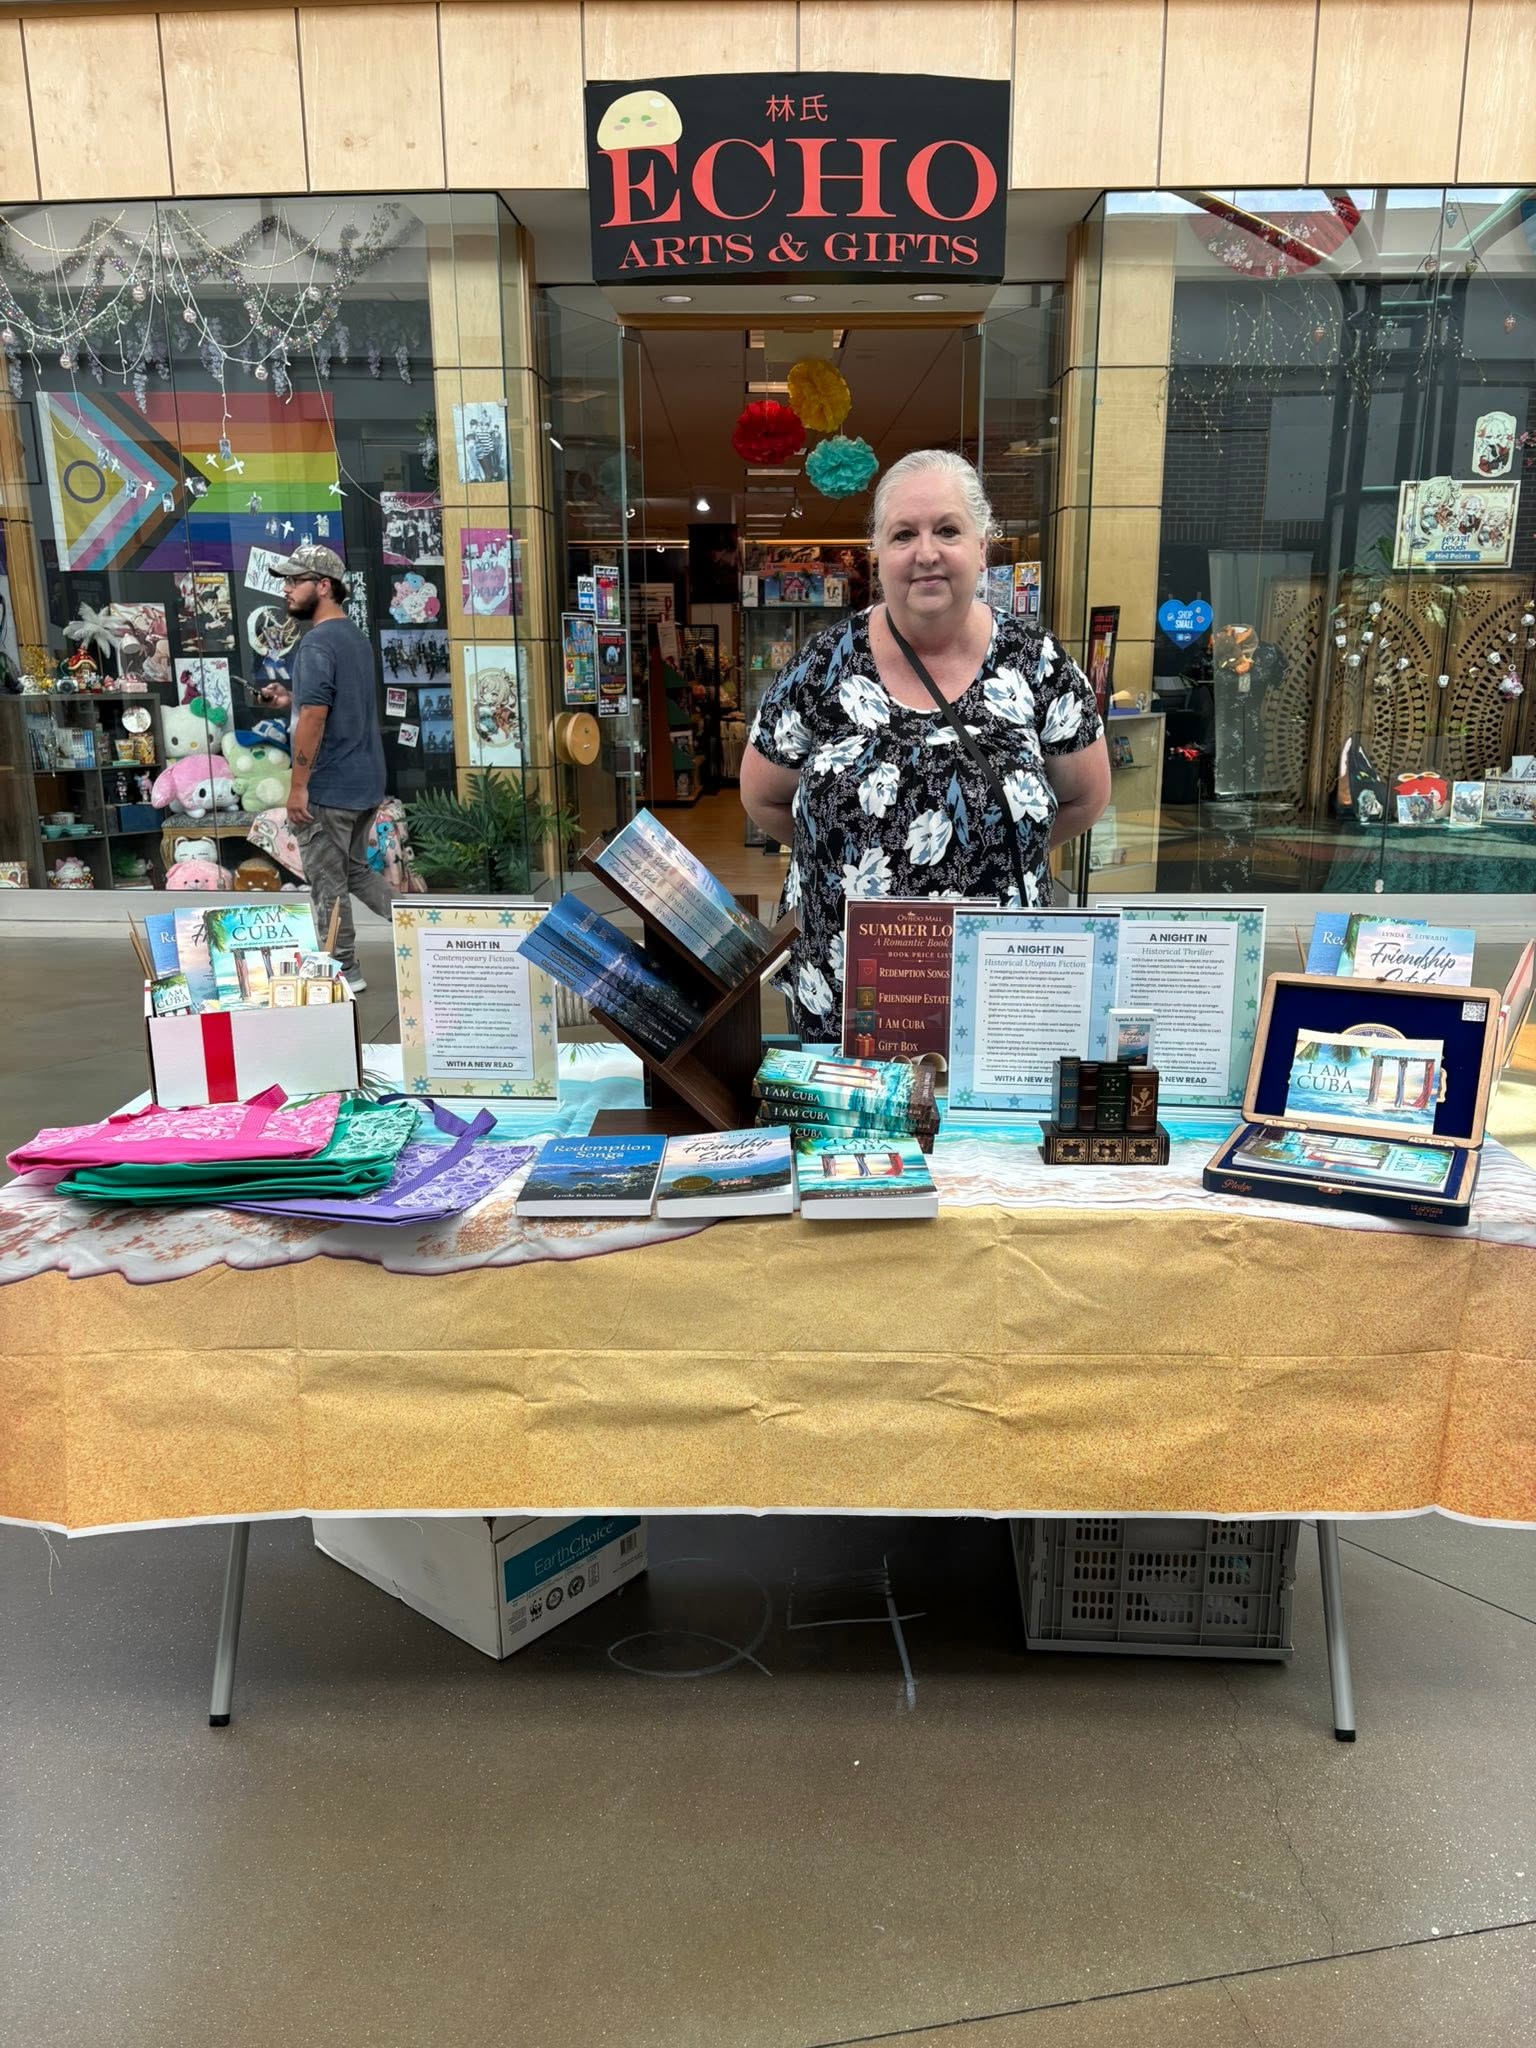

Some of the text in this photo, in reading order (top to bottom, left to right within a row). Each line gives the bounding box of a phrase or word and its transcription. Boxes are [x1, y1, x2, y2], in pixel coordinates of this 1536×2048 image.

[765, 94, 829, 123] 林氏
[597, 137, 998, 228] ECHO
[618, 231, 979, 269] ARTS & GIFTS
[1441, 542, 1467, 551] Goods
[579, 581, 594, 592] OPEN
[1177, 610, 1193, 620] SHOP
[1175, 619, 1194, 630] SMALL
[239, 910, 283, 926] I AM
[232, 924, 293, 942] CUBA
[859, 924, 928, 937] SUMMER
[874, 938, 949, 947] A Romantic Book
[1149, 933, 1207, 943] A NIGHT IN
[1415, 933, 1449, 942] EDWARDS
[446, 940, 500, 950] A NIGHT IN
[1007, 945, 1064, 954] A NIGHT IN
[1141, 947, 1214, 956] Historical Thriller
[433, 953, 515, 964] Contemporary Fiction
[984, 958, 1086, 969] Historical Utopian Fiction
[1371, 941, 1456, 977] Friendship
[879, 967, 950, 978] REDEMPTION SONGS
[169, 988, 184, 997] AM
[879, 992, 951, 1004] FRIENDSHIP ESTATE
[156, 995, 190, 1009] CUBA
[878, 1018, 926, 1030] I AM CUBA
[878, 1040, 919, 1052] GIFT BOX
[446, 1060, 466, 1068] WITH
[493, 1061, 514, 1069] READ
[1307, 1062, 1348, 1078] I AM
[994, 1074, 1016, 1082] WITH
[1016, 1075, 1023, 1083] A
[1024, 1075, 1043, 1083] NEW
[1165, 1076, 1184, 1084] NEW
[1185, 1076, 1208, 1084] READ
[1296, 1074, 1353, 1094] CUBA
[764, 1086, 820, 1103] I AM CUBA
[774, 1107, 830, 1121] I AM CUBA
[795, 1127, 824, 1138] CUBA
[554, 1143, 651, 1153] Redemption
[683, 1137, 773, 1154] Friendship
[822, 1143, 893, 1151] CUBA
[575, 1151, 624, 1160] Songs
[697, 1149, 757, 1162] Estate
[1221, 1178, 1253, 1194] Pledge
[533, 1521, 615, 1577] EarthChoice
